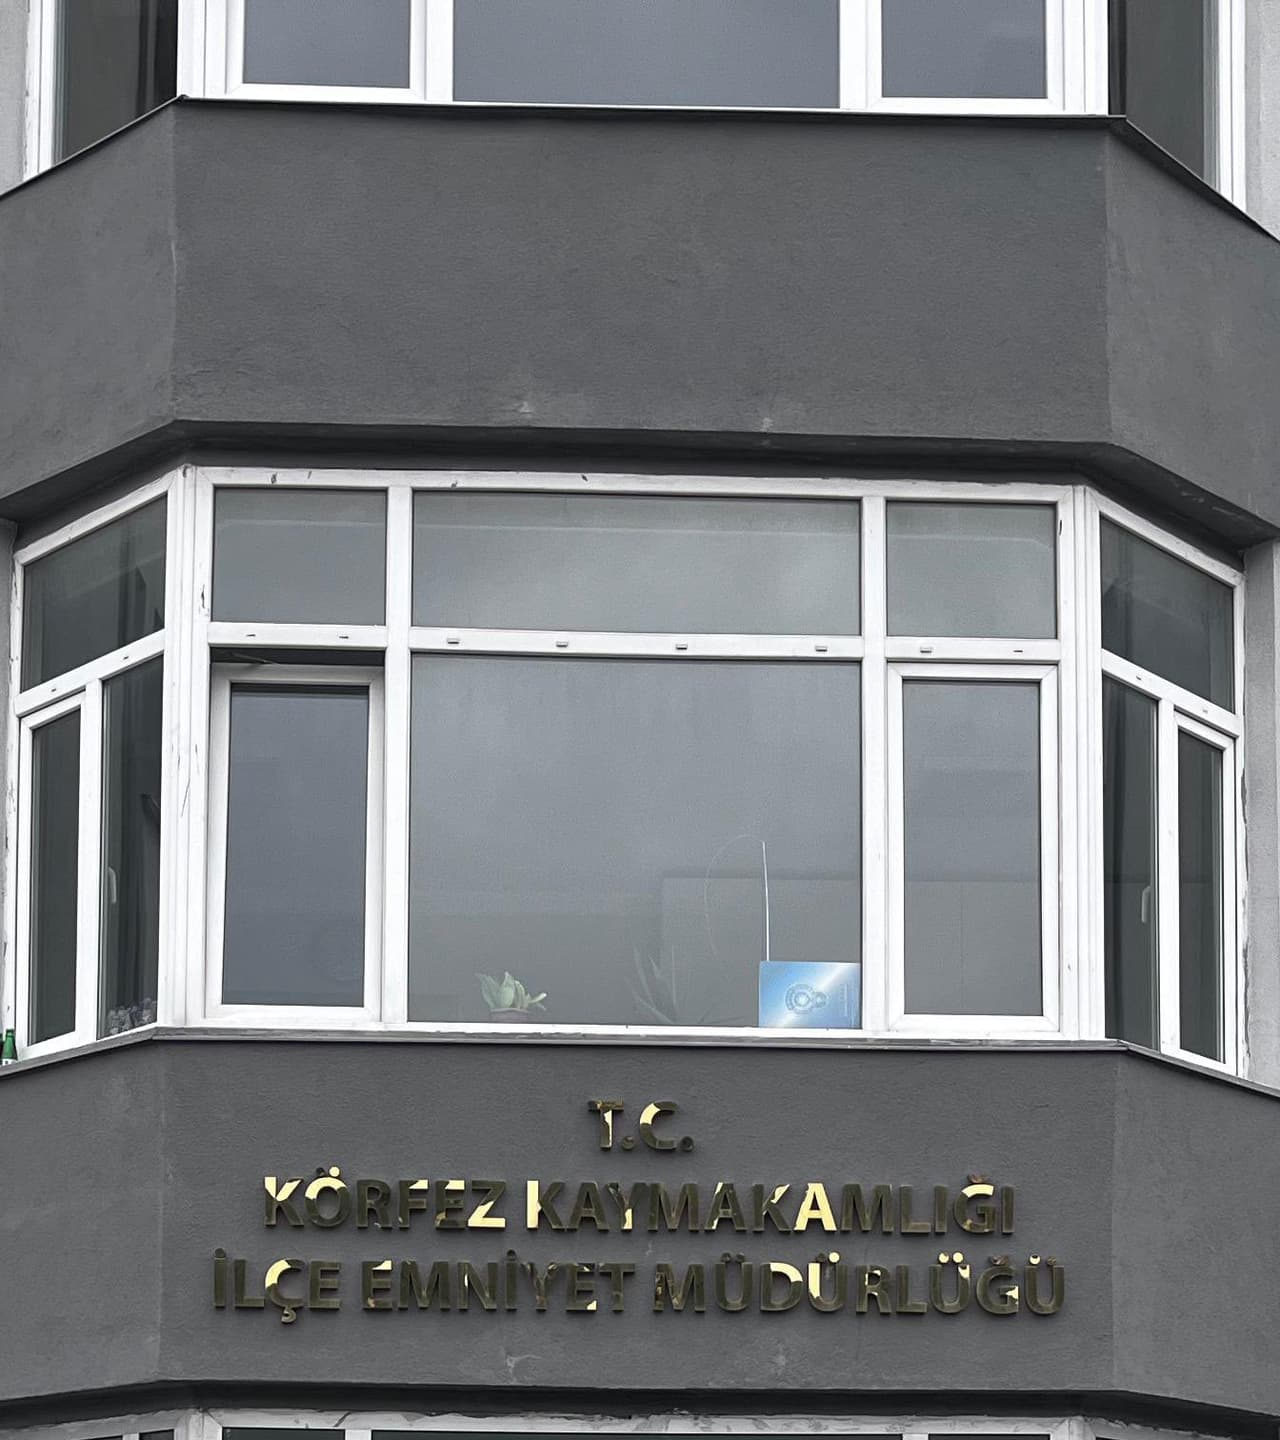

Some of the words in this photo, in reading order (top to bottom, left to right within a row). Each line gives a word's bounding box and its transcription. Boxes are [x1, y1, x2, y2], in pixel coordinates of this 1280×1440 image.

[586, 1098, 695, 1153] T.C.
[261, 1165, 507, 1231] KÖRFEZ
[527, 1174, 1015, 1235] KAYMAKAMLIĞI
[212, 1246, 342, 1325] İLÇE
[360, 1248, 636, 1315] EMNİYET
[653, 1250, 1068, 1316] MÜDÜRLÜĞÜ
